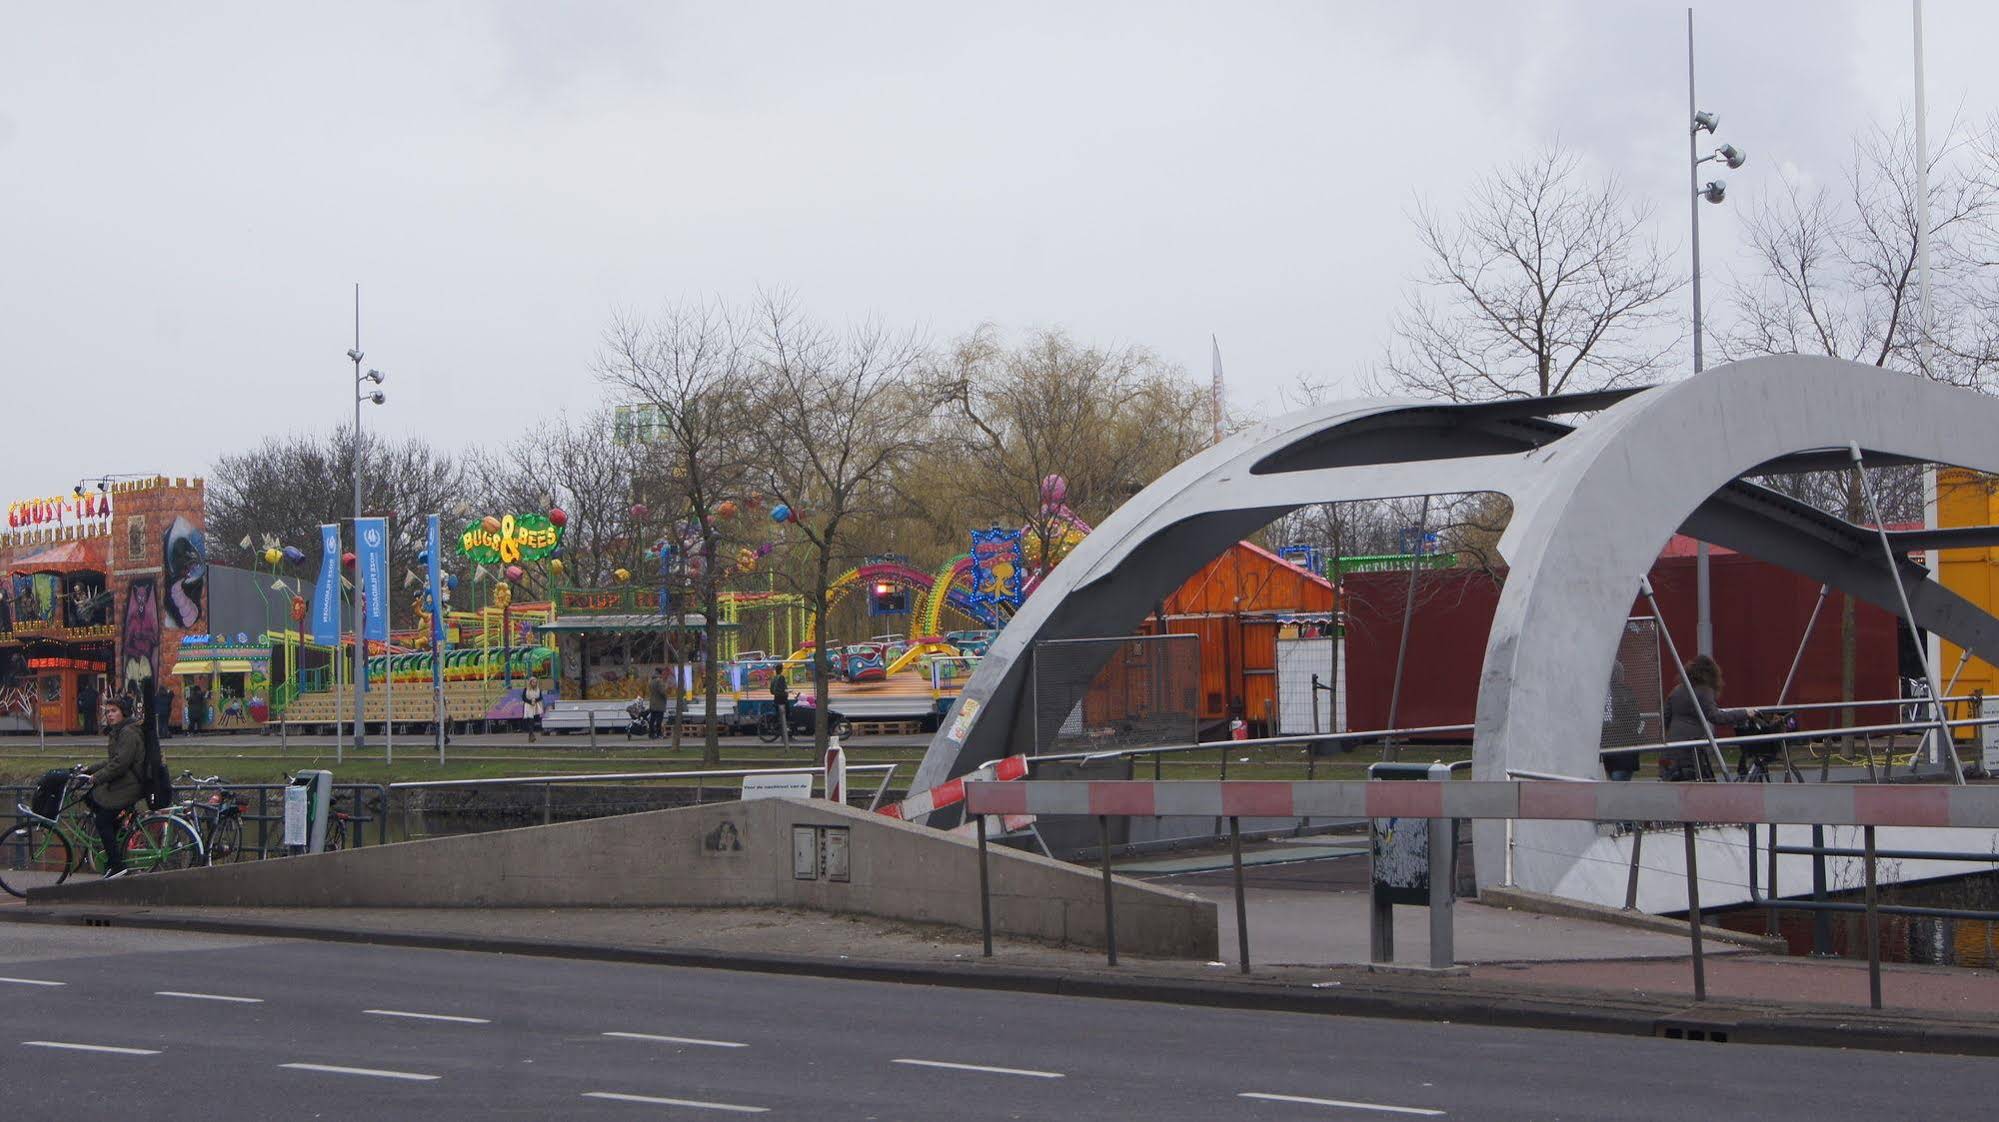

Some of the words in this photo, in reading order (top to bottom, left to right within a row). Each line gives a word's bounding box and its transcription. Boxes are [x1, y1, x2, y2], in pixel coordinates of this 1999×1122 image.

[463, 529, 501, 551] BUGS
[501, 514, 520, 563] &
[519, 527, 557, 548] BEES
